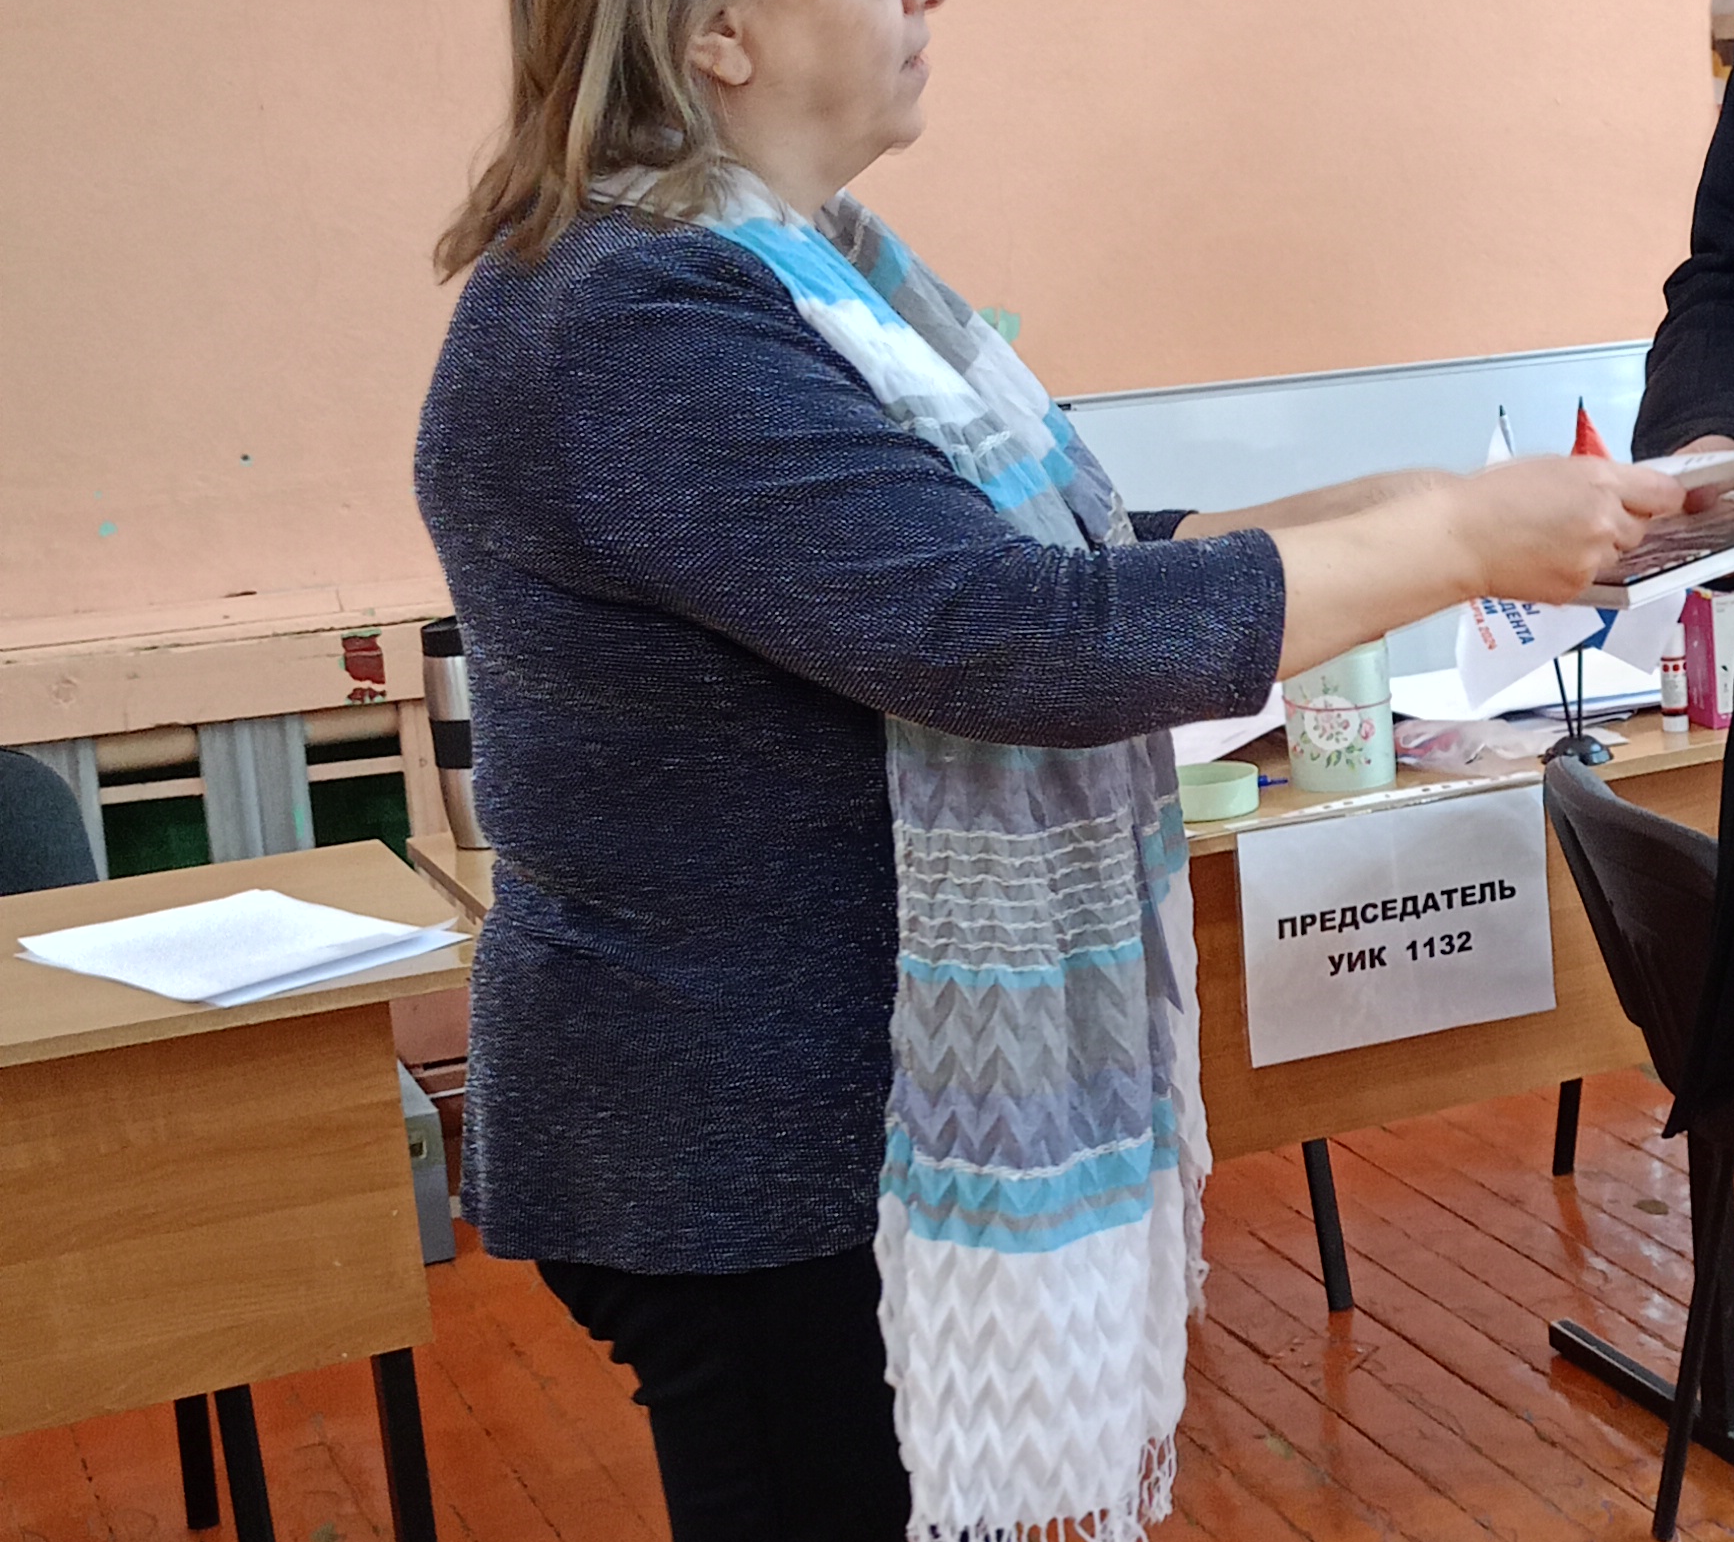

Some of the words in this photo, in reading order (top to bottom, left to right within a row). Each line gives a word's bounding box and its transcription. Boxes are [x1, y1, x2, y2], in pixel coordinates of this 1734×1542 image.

[1278, 879, 1517, 940] ПРЕДСЕДАТЕЛЬ
[1327, 945, 1388, 977] УИК
[1405, 930, 1474, 961] 1132
